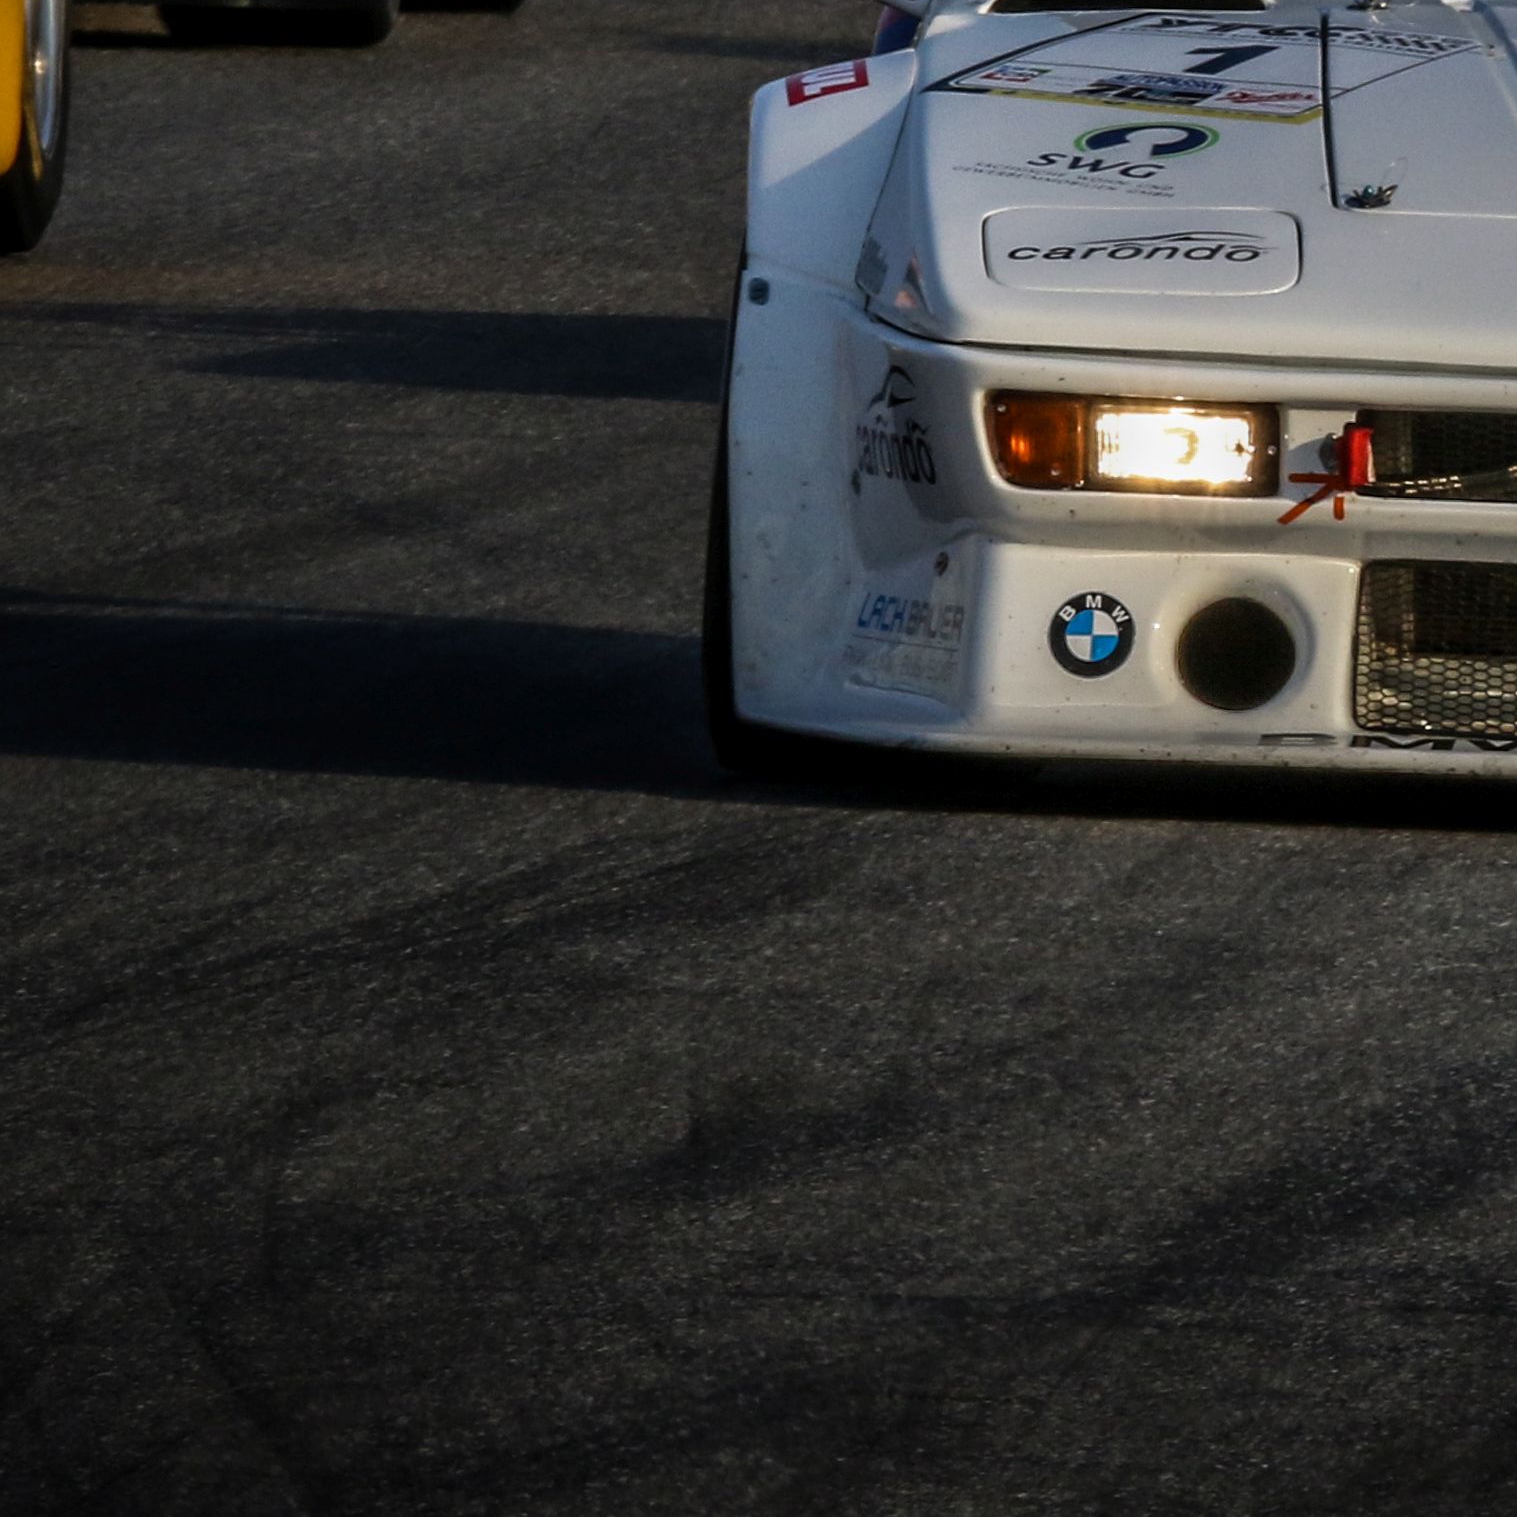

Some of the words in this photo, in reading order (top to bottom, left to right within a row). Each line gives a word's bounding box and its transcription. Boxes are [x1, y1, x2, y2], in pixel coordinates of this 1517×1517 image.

[1183, 44, 1281, 75] 1
[1027, 153, 1166, 180] SWG
[1007, 240, 1263, 263] carondo
